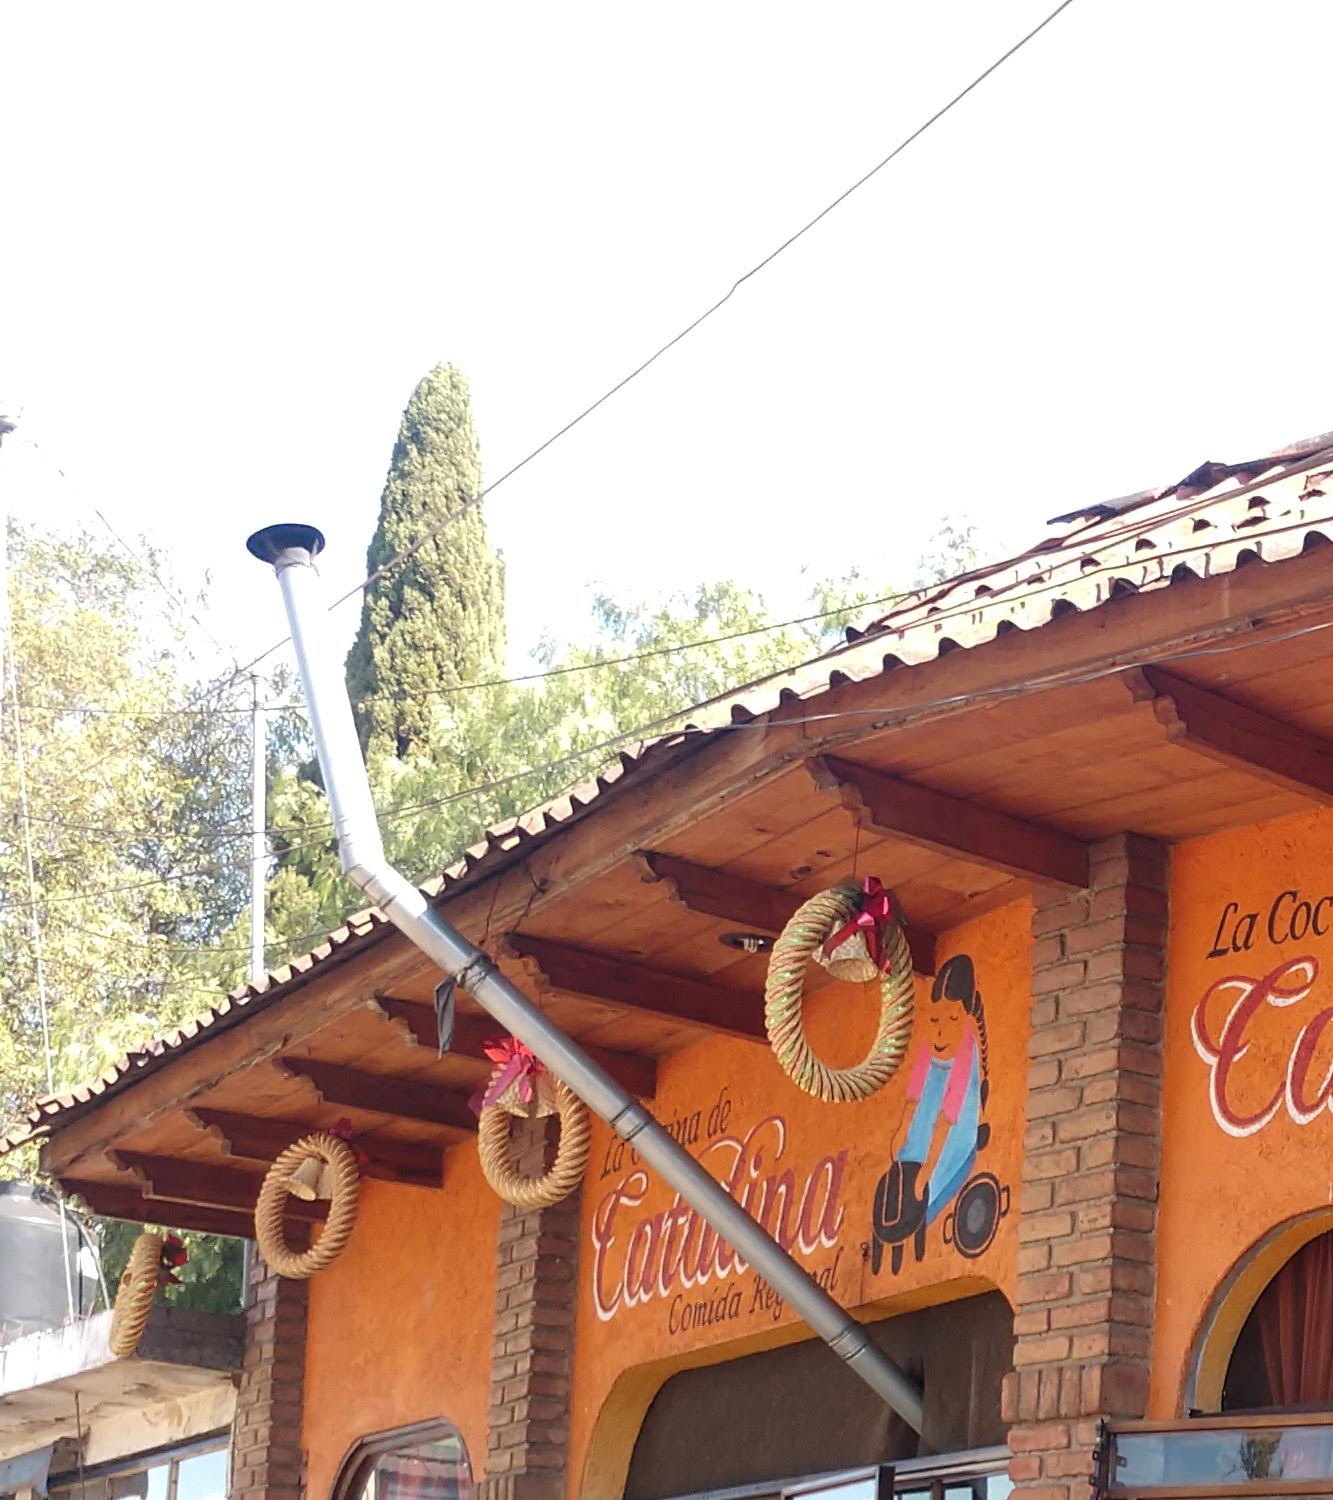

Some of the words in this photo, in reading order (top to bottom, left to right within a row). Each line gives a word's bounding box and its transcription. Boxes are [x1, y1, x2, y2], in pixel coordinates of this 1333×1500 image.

[1206, 902, 1259, 959] La
[599, 1133, 625, 1178] La
[707, 1085, 731, 1138] de
[668, 1282, 743, 1335] Comida
